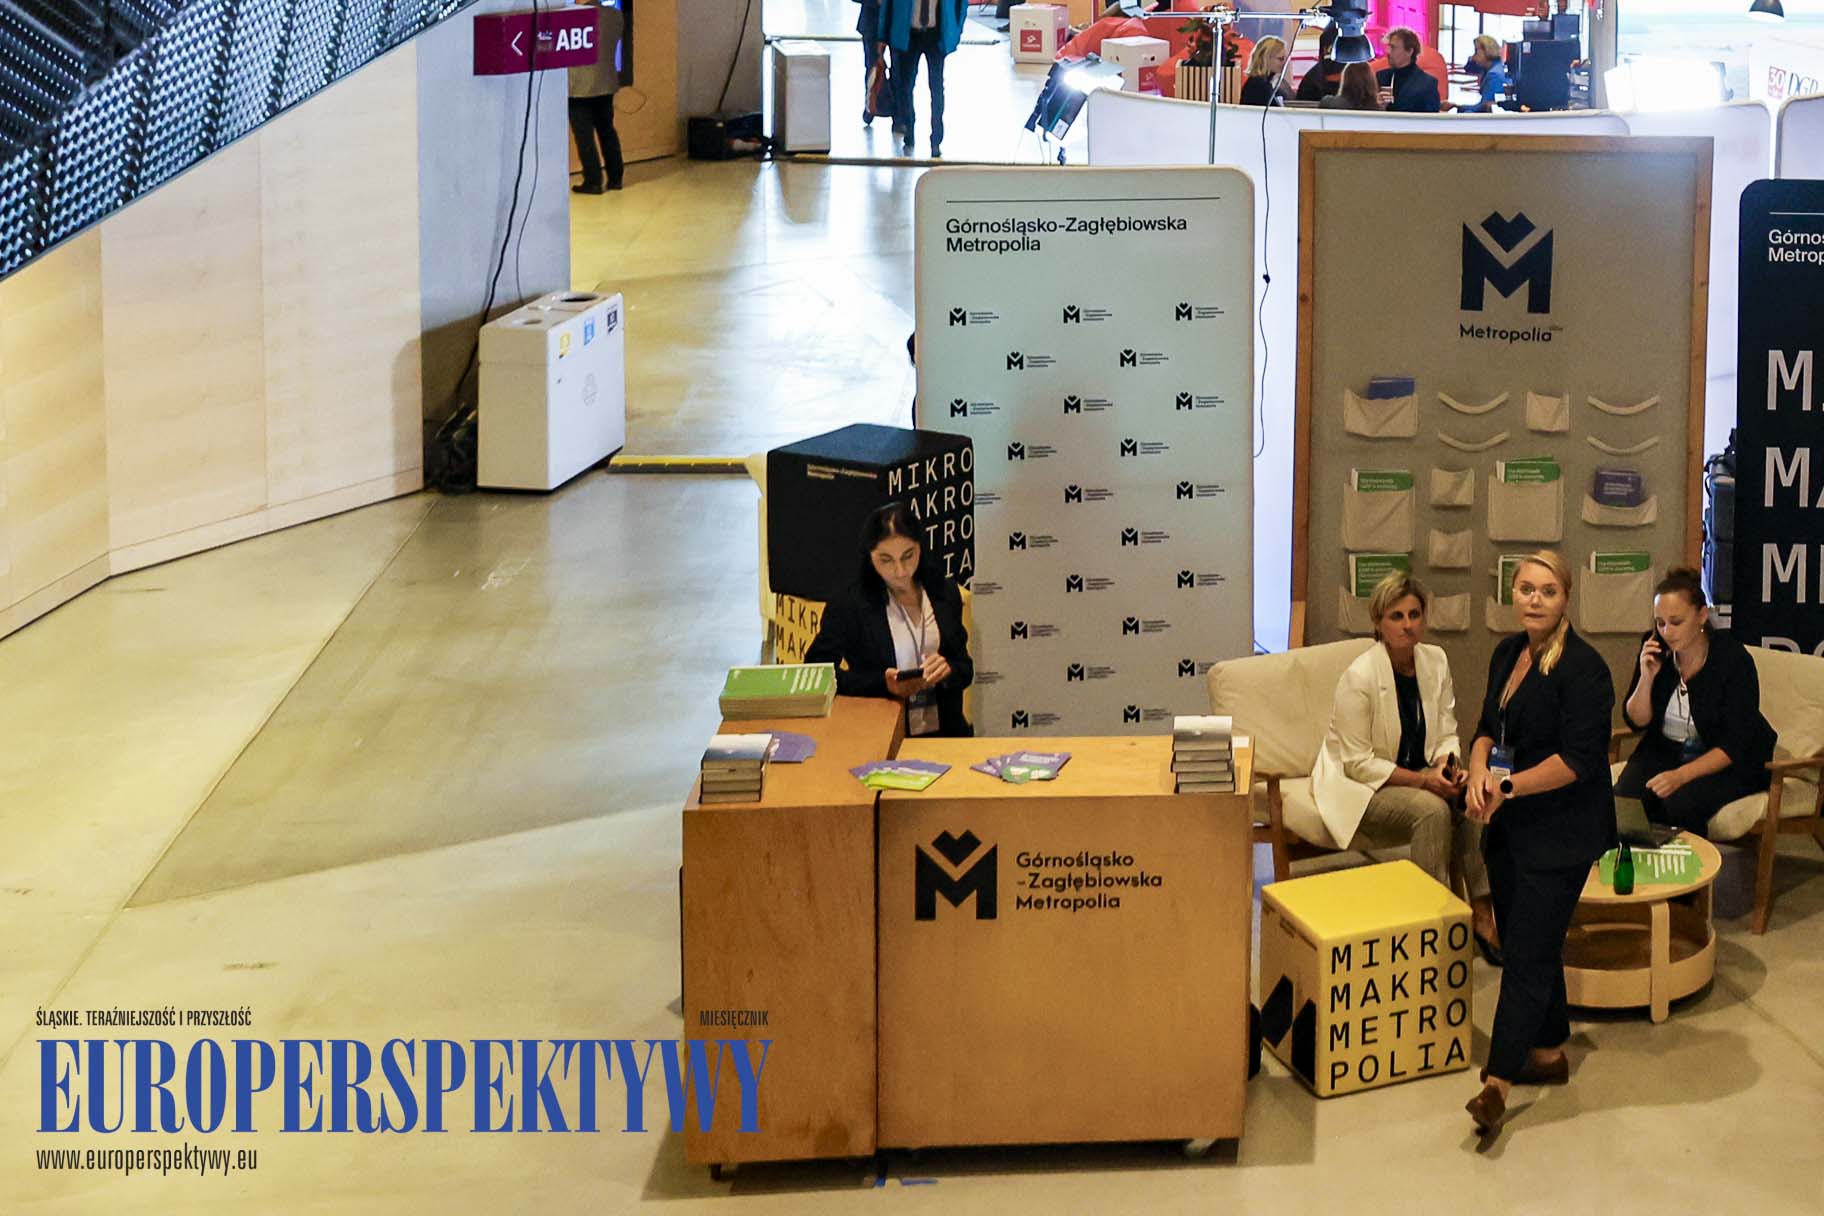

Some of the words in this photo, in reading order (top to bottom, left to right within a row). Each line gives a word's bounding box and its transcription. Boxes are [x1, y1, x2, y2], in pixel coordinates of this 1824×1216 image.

[556, 26, 594, 51] ABC
[946, 216, 1187, 236] Górnośląsko-Zagłębiowska
[946, 235, 1041, 254] Metropolia
[1460, 323, 1552, 344] Metropolia
[888, 447, 973, 496] MIKRO
[925, 514, 973, 550] TRO
[775, 592, 819, 634] MIKR
[1016, 850, 1134, 871] Górnośląsko
[1016, 894, 1121, 912] Metropolia
[1331, 922, 1469, 974] MIKRO
[1330, 960, 1468, 1013] MAKRO
[1329, 998, 1467, 1052] METRO
[1330, 1036, 1465, 1090] POLIA
